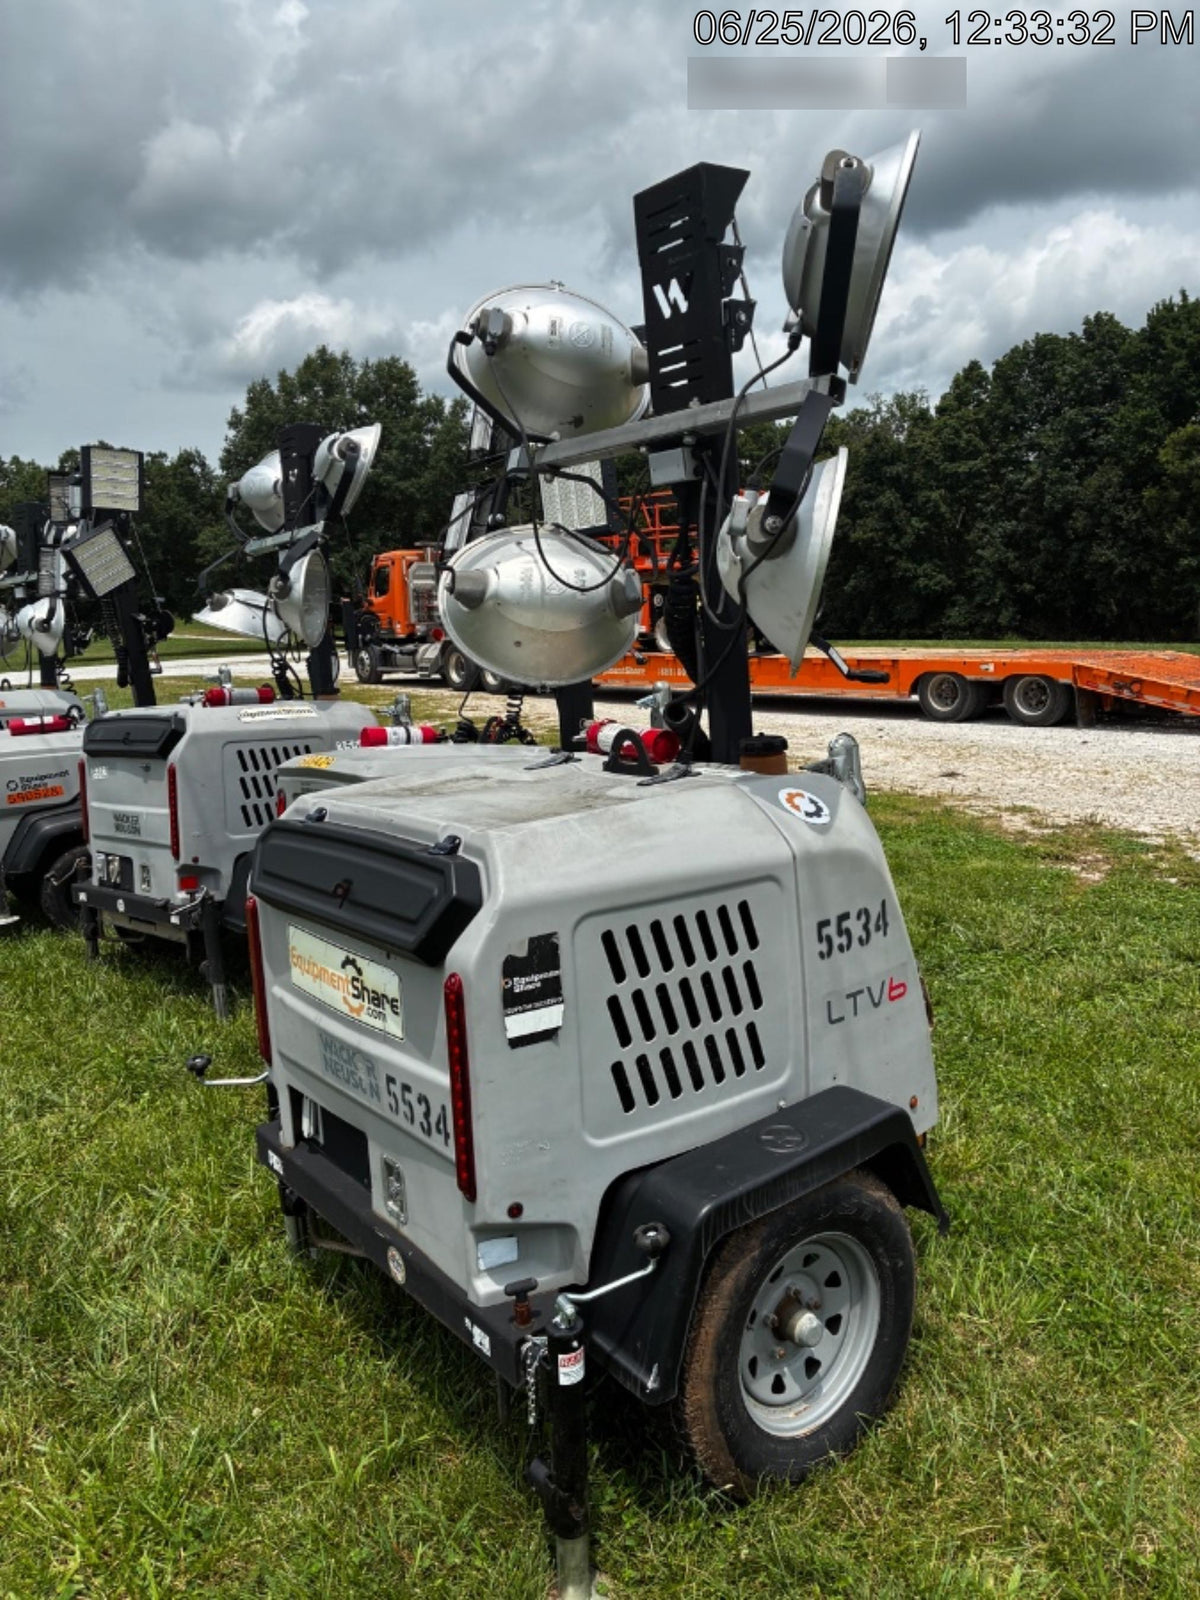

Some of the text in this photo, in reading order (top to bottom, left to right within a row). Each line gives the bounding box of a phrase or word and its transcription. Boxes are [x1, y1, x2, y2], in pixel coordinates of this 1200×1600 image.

[815, 898, 890, 960] 5534
[289, 945, 400, 1016] EquipmentShare
[826, 976, 908, 1025] LTV6
[319, 1029, 378, 1082] WACKR
[385, 1073, 451, 1148] 5534
